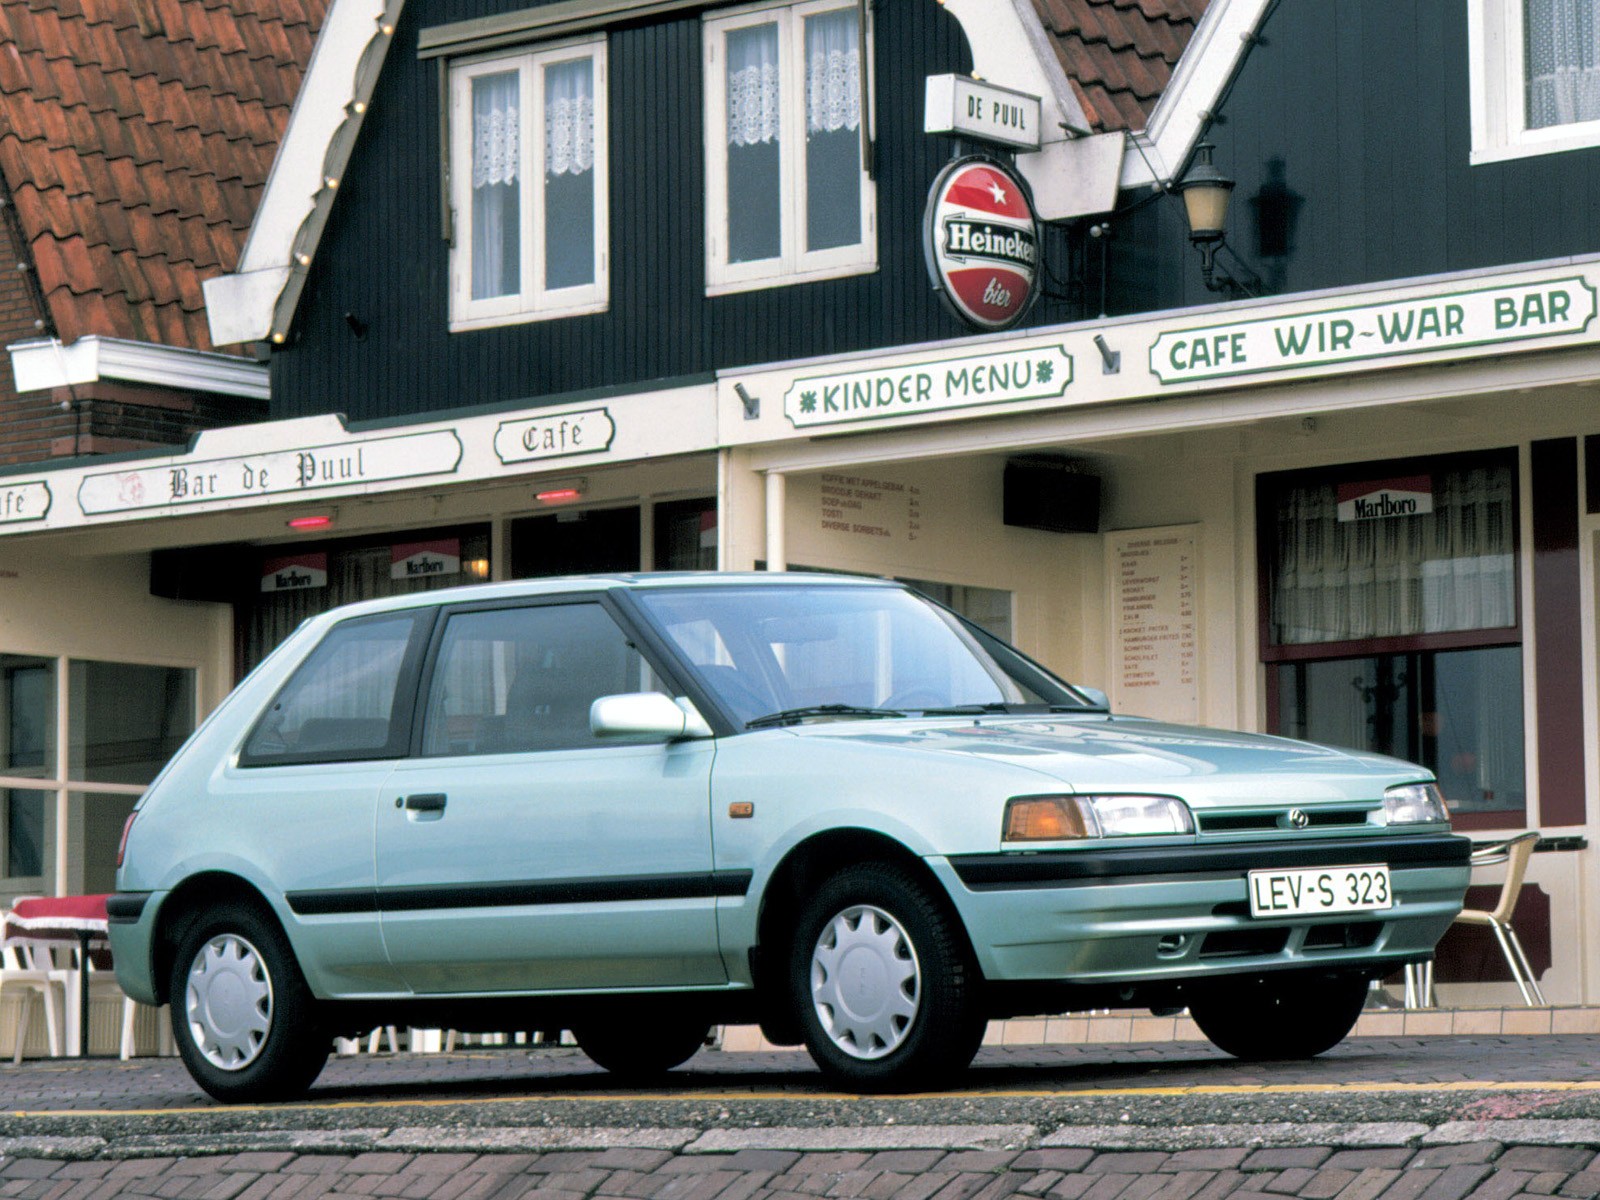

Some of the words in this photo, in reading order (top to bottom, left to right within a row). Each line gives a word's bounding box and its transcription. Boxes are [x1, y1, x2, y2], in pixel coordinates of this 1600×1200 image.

[968, 95, 982, 120] DE
[993, 101, 1026, 130] PUUL
[982, 277, 1011, 307] bier
[1169, 332, 1247, 370] CAFE
[1494, 290, 1571, 330] BAR
[823, 373, 932, 413] KINDER
[946, 360, 1032, 397] MENU
[522, 416, 586, 452] Café
[169, 467, 218, 499] Bar
[243, 463, 269, 490] de
[295, 448, 366, 487] Puul
[1354, 493, 1417, 519] Marlboro
[407, 557, 444, 576] Marlboro
[1255, 874, 1335, 911] LEV-S
[1345, 871, 1388, 906] 323
